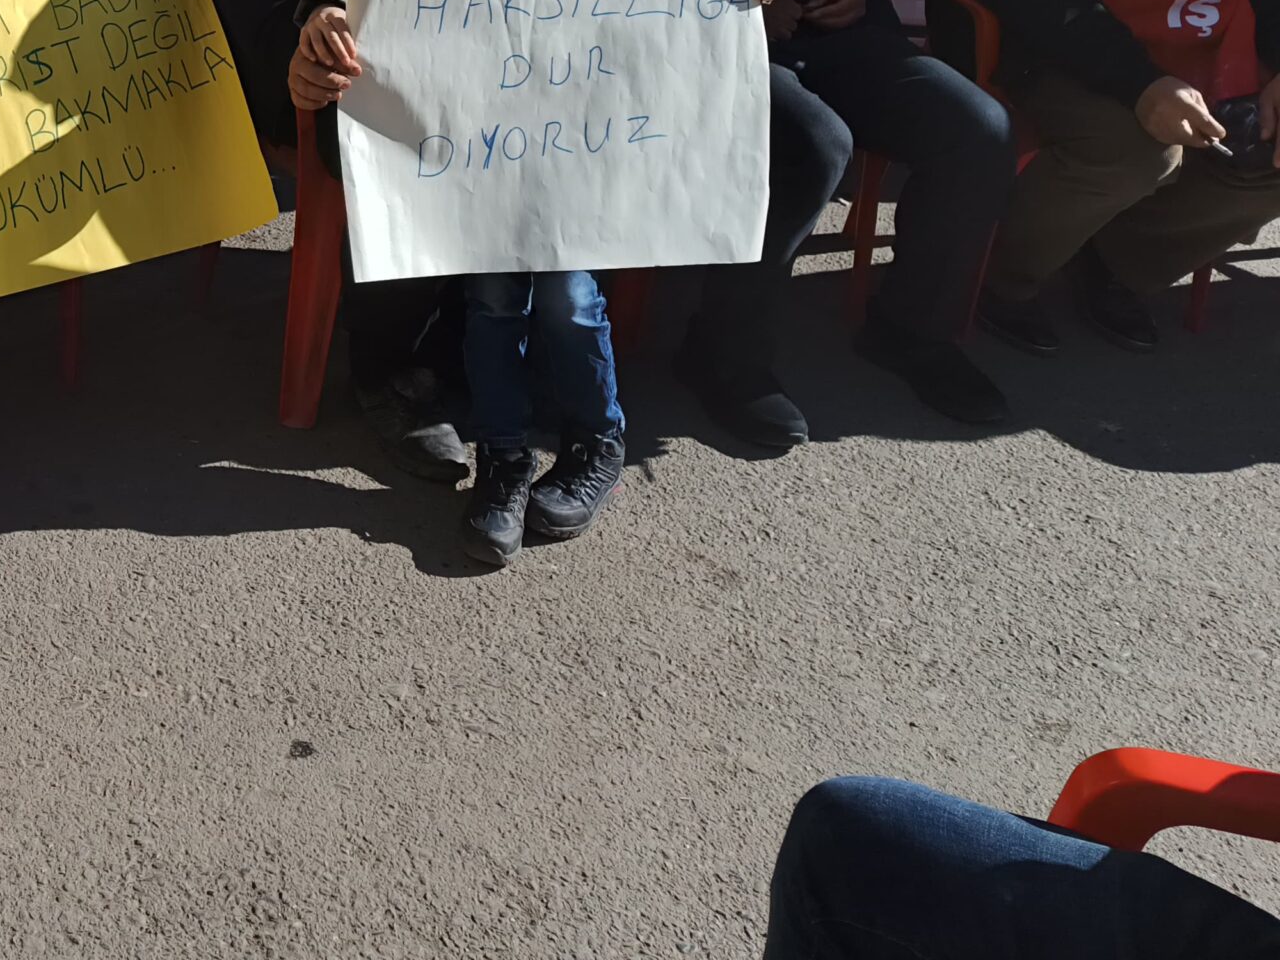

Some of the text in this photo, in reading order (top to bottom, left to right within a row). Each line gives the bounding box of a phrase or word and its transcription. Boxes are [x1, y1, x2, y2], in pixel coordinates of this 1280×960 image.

[101, 2, 216, 71] DEĞİL
[500, 46, 616, 90] DUR
[25, 46, 234, 155] BAKMAKLA
